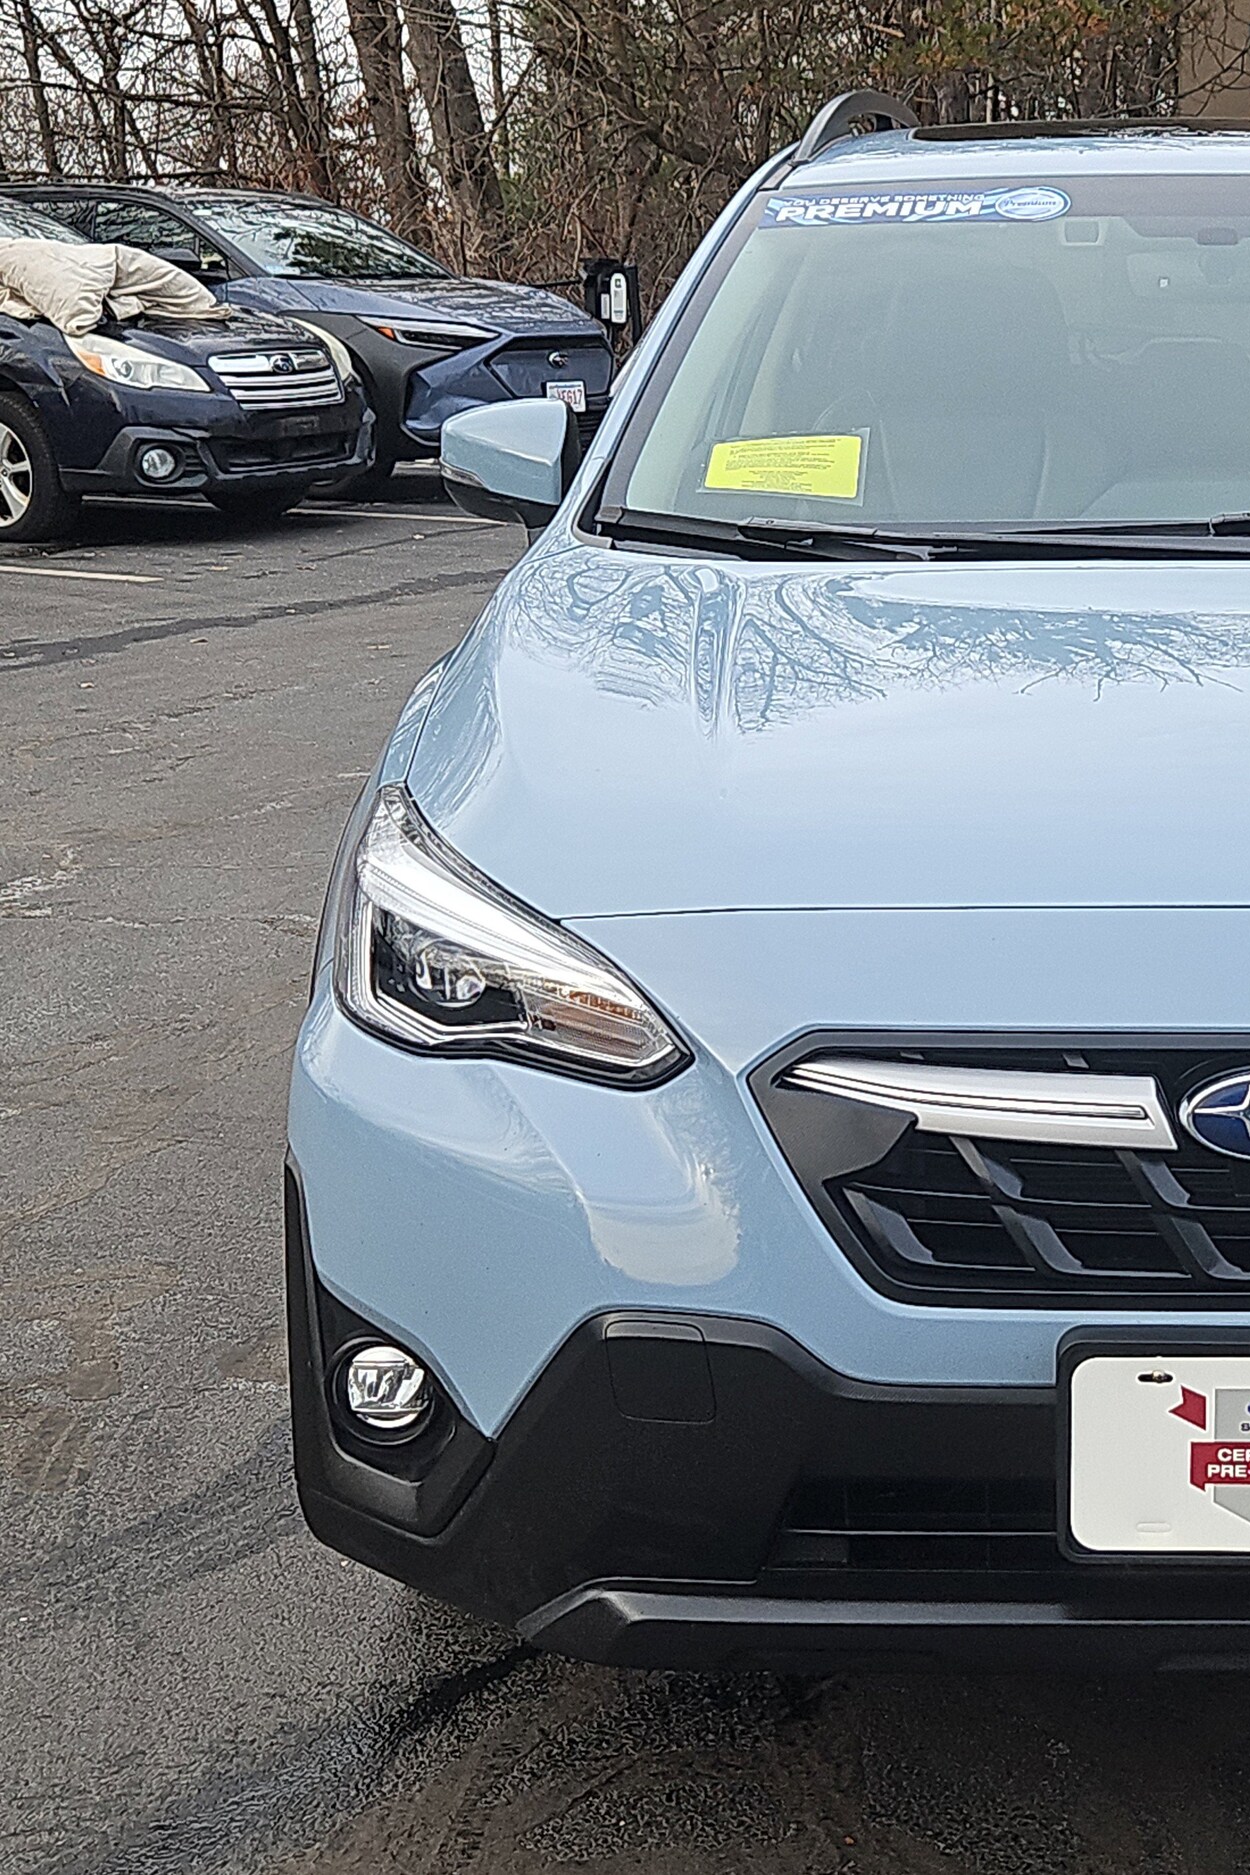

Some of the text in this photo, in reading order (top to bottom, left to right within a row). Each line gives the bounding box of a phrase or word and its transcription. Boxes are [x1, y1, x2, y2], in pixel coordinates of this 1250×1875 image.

[783, 193, 985, 207] YOU DESERVE SOMETHING
[775, 200, 983, 222] PREMIUM
